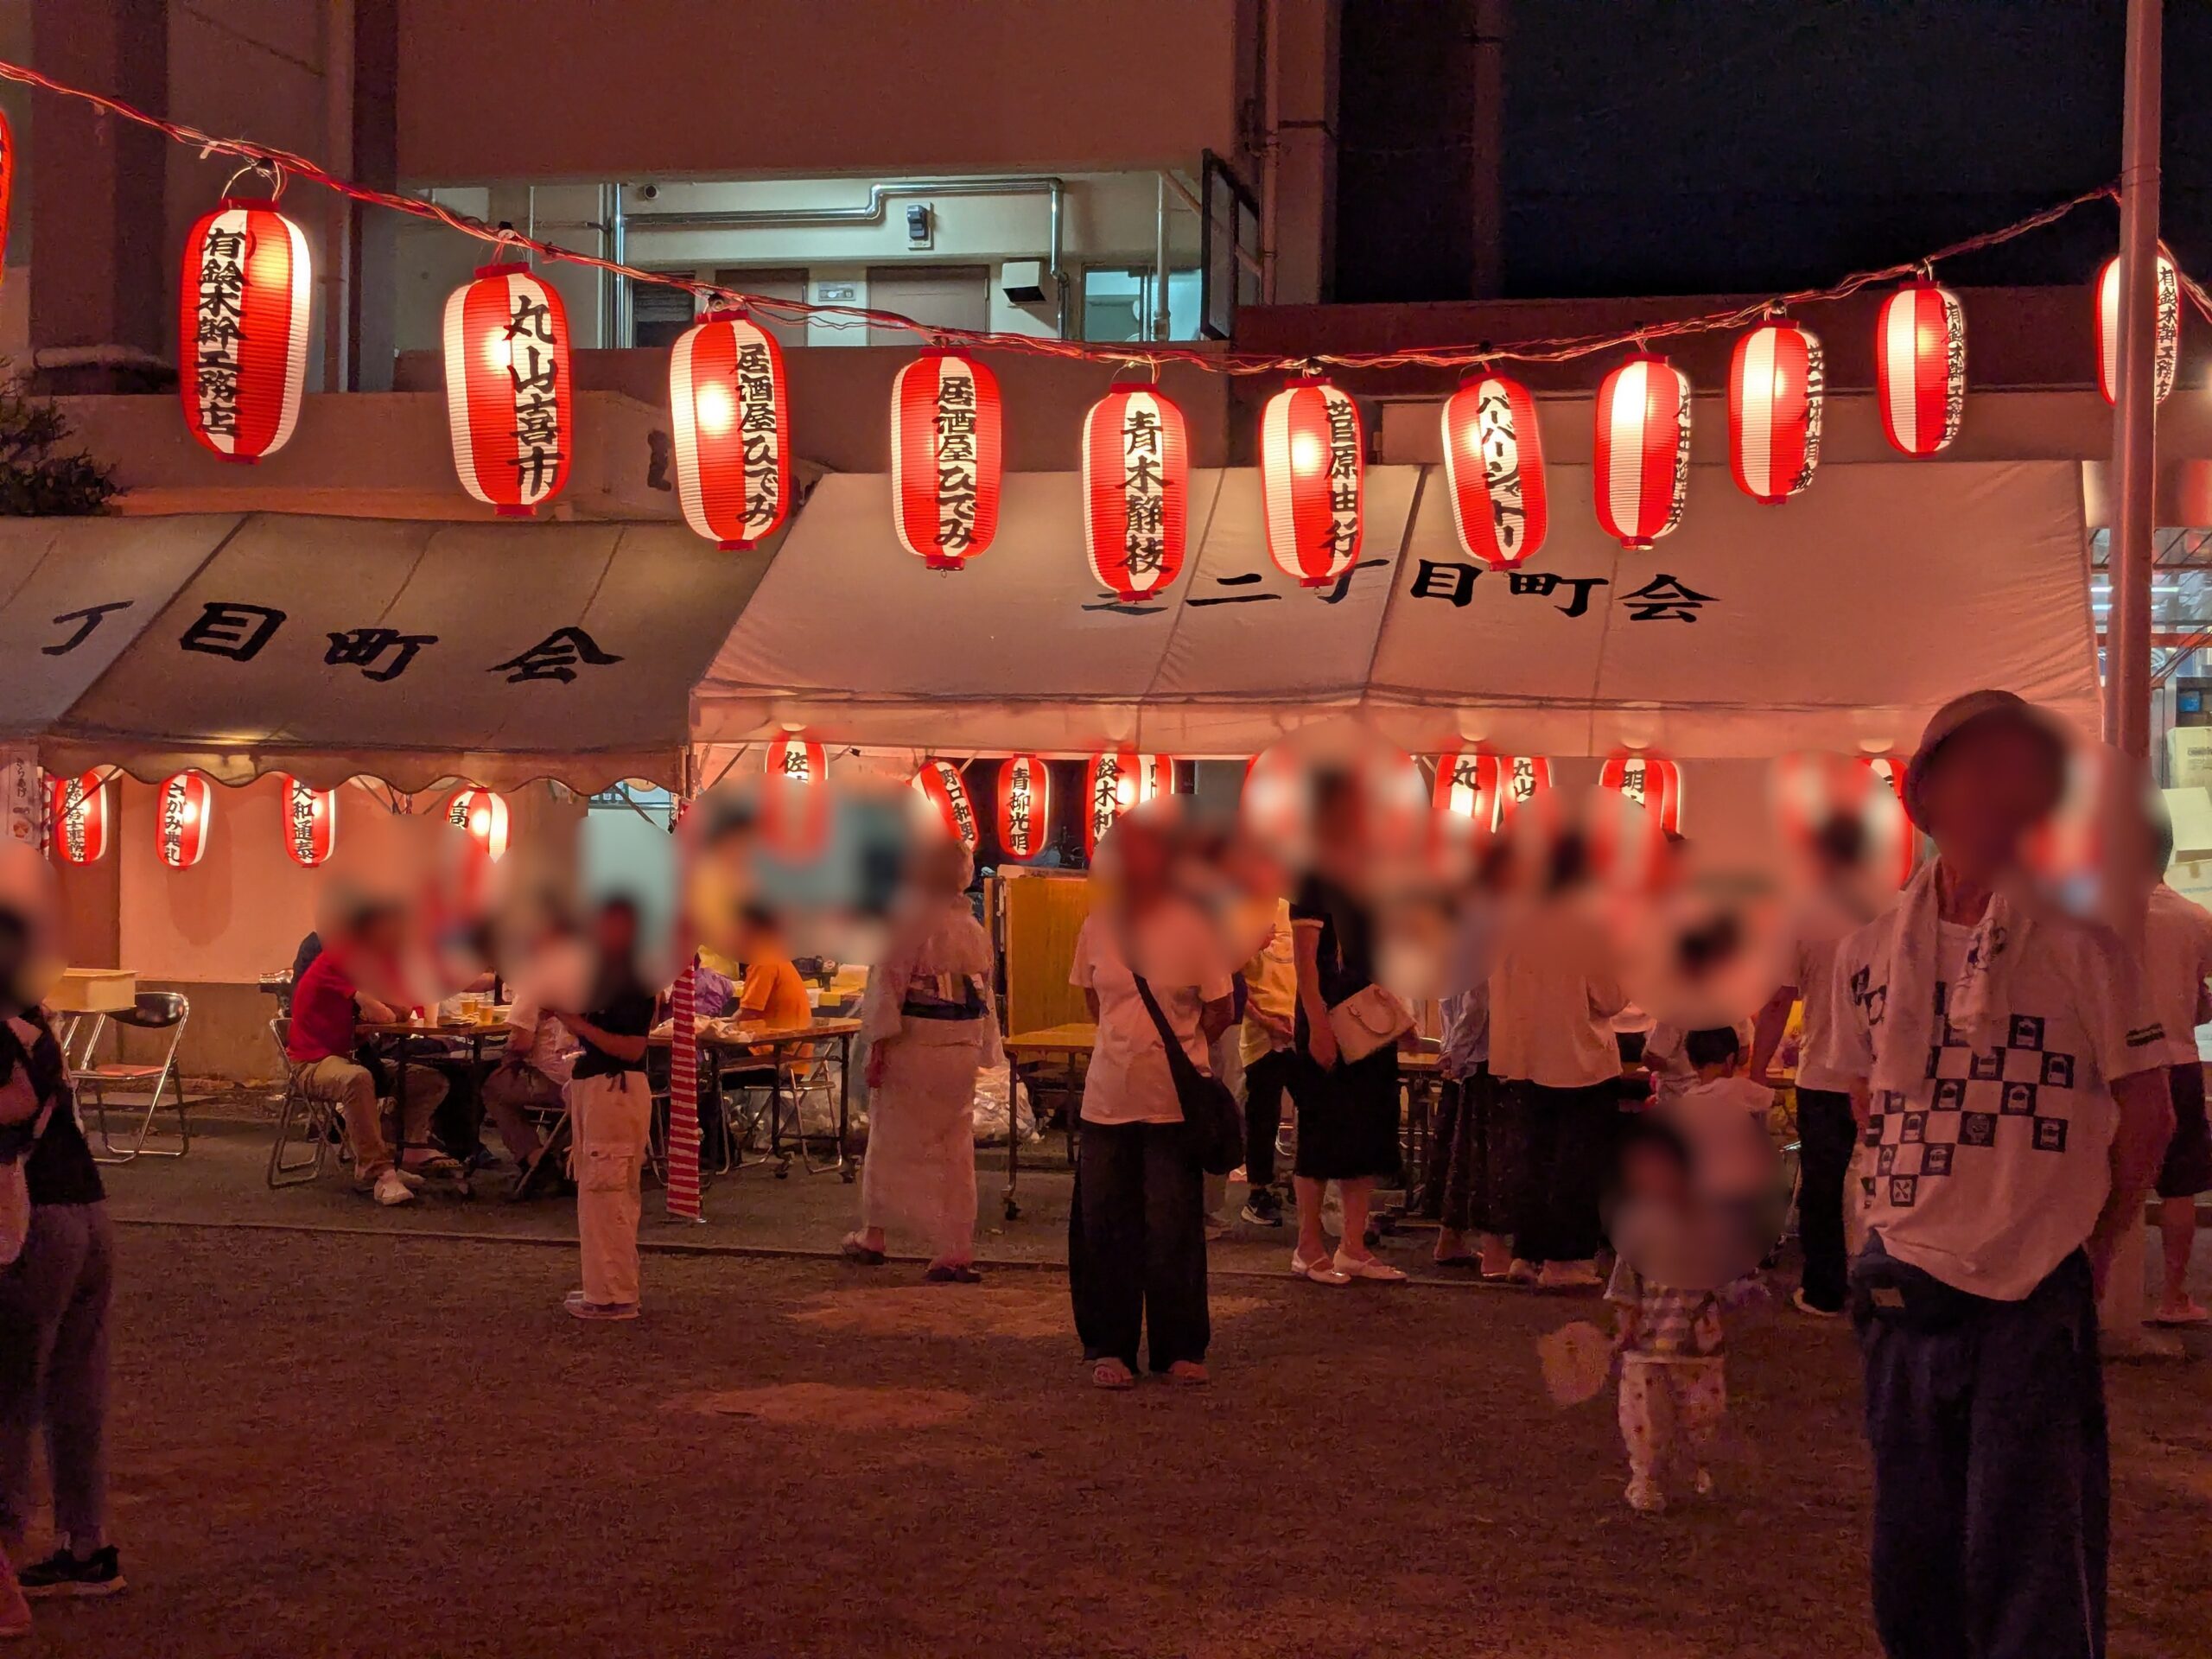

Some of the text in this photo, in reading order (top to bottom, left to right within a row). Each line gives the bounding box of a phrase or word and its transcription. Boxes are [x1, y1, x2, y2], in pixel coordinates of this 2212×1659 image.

[504, 295, 564, 497] 丸山喜市
[731, 343, 779, 527] 居酒屋ひでみ
[932, 376, 979, 549] 居酒屋ひでみ
[1116, 410, 1174, 575] 青木静枝
[1081, 557, 1721, 624] 二丁目町会
[1007, 767, 1033, 851] 青柳光明
[1090, 758, 1126, 847] 鈴木利
